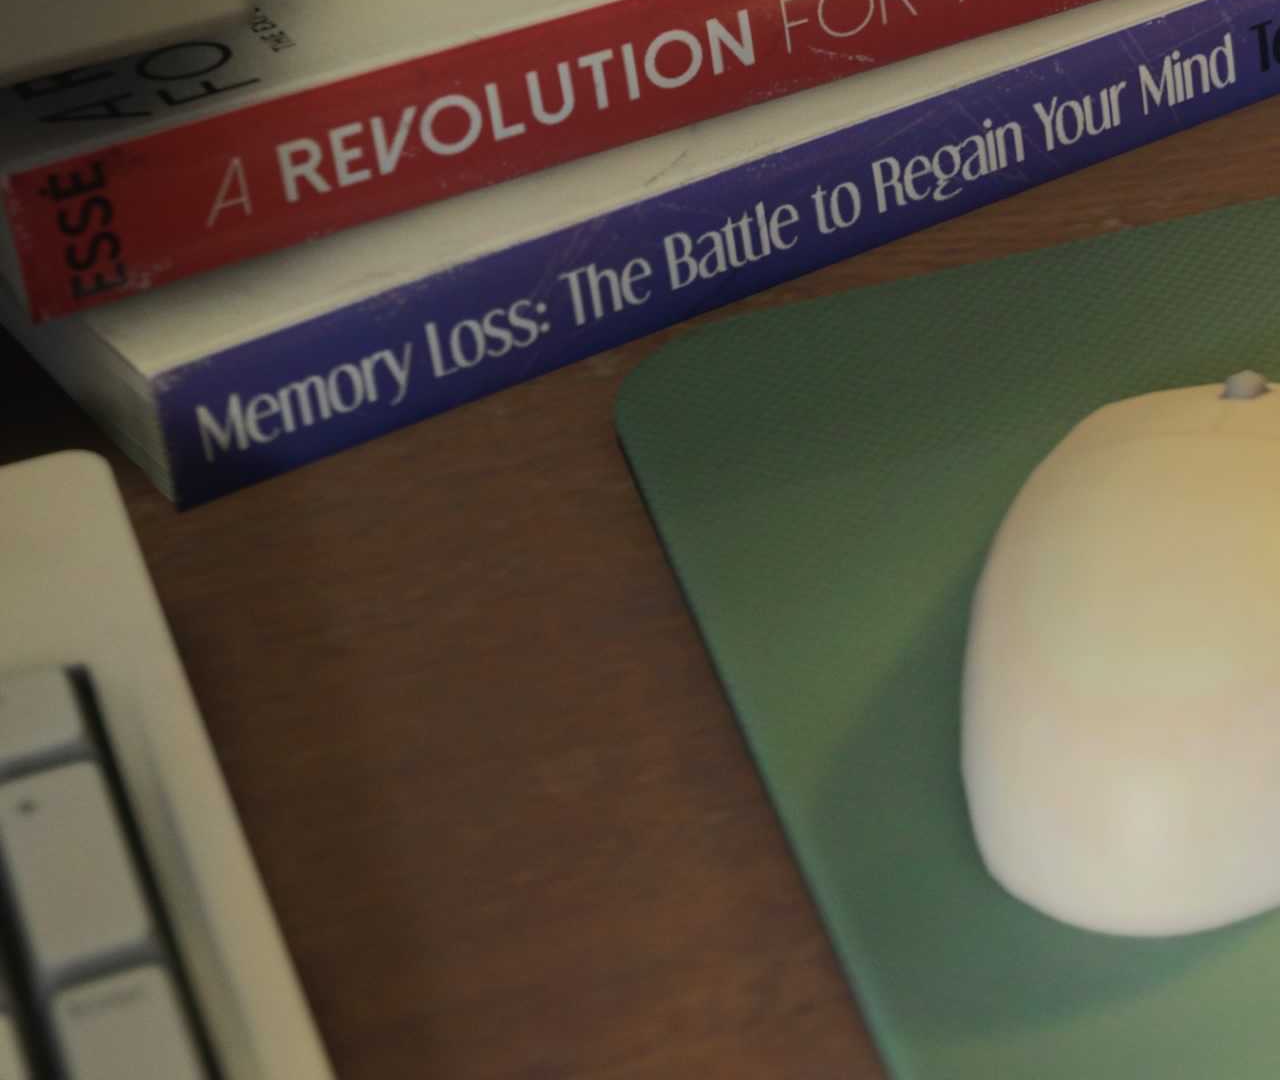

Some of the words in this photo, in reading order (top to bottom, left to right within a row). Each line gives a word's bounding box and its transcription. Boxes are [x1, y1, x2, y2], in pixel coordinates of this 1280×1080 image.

[135, 39, 262, 108] FO
[206, 156, 254, 228] A
[274, 9, 758, 205] REVOLUTION
[194, 341, 414, 465] Memory
[424, 297, 553, 379] Loss:
[557, 258, 653, 328] The
[663, 200, 799, 293] Battle
[811, 180, 862, 236] to
[870, 117, 1027, 215] Regain
[1032, 79, 1127, 155] Your
[1137, 34, 1238, 116] Mind
